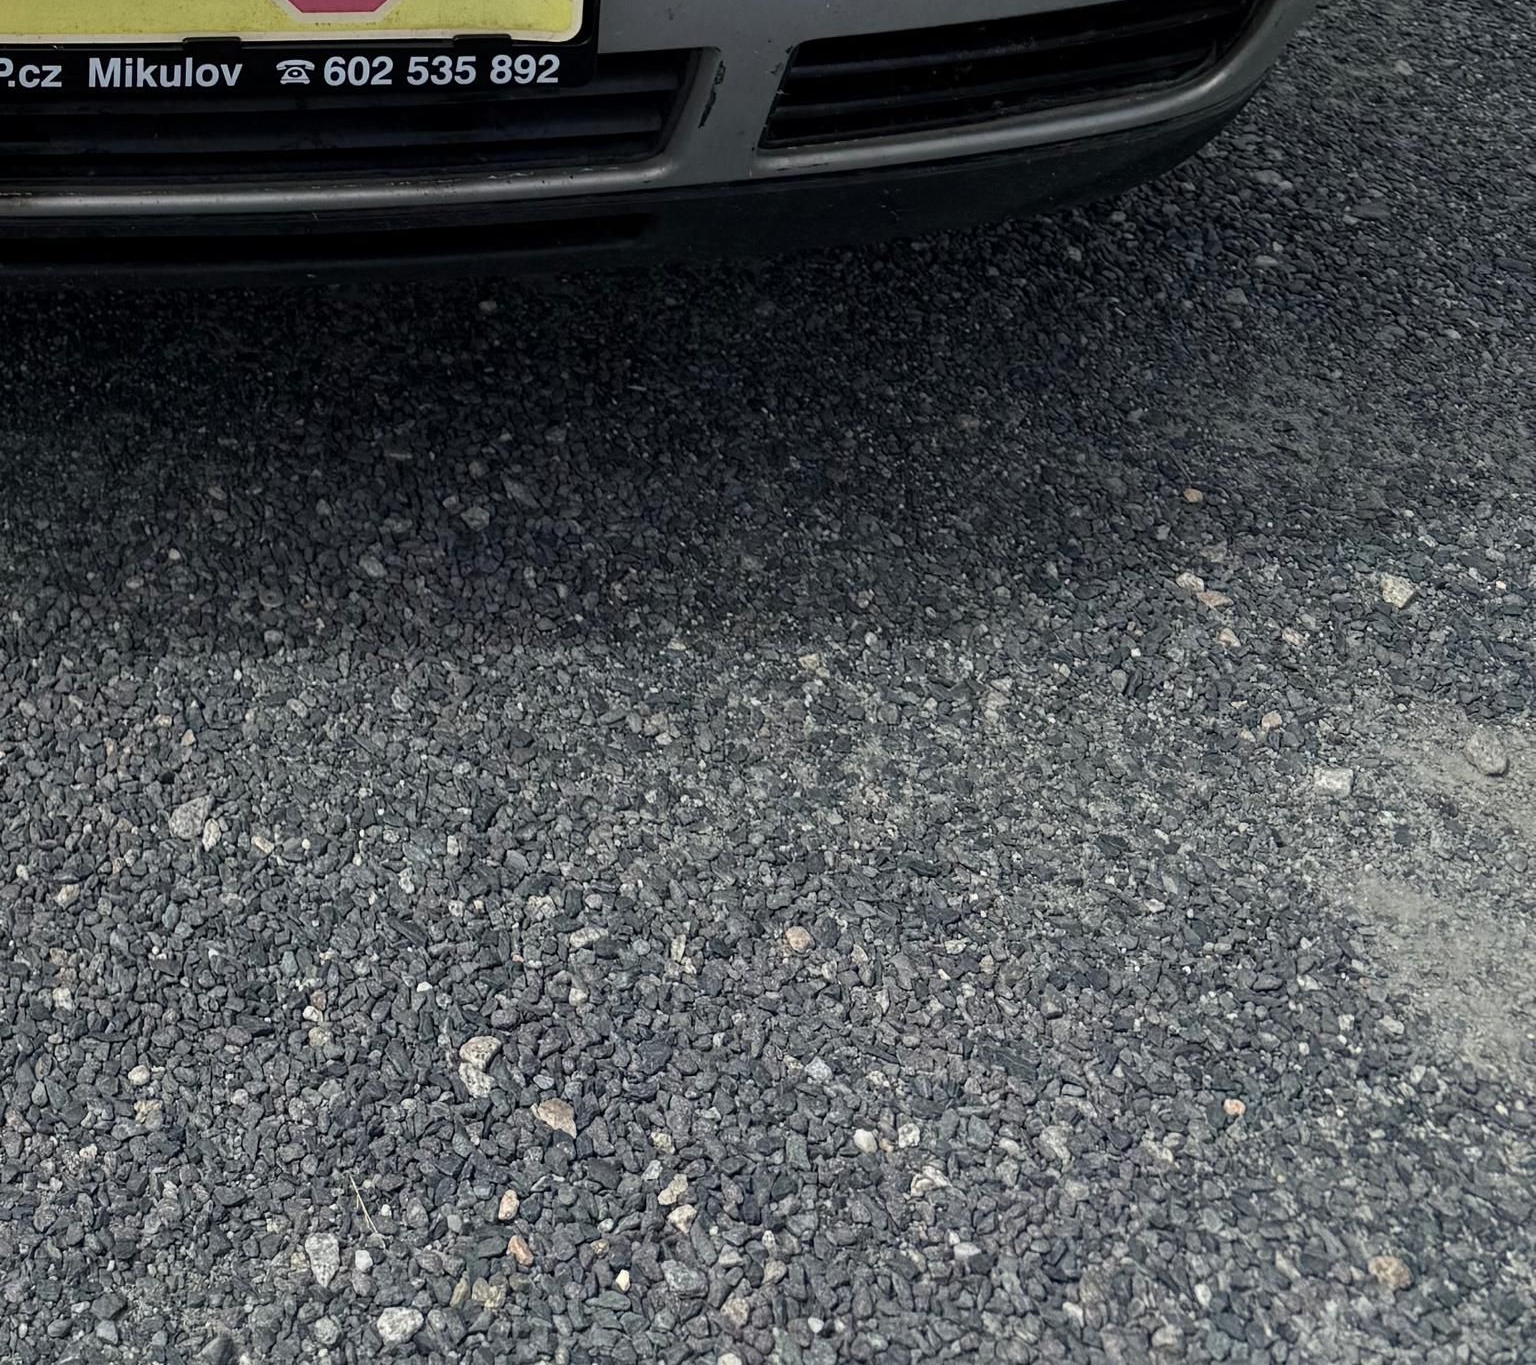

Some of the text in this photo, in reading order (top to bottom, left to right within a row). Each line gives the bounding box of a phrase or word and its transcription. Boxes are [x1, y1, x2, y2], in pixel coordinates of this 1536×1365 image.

[88, 57, 243, 88] Mikulov
[323, 55, 394, 87] 602
[406, 55, 477, 86] 535
[489, 54, 561, 85] 892
